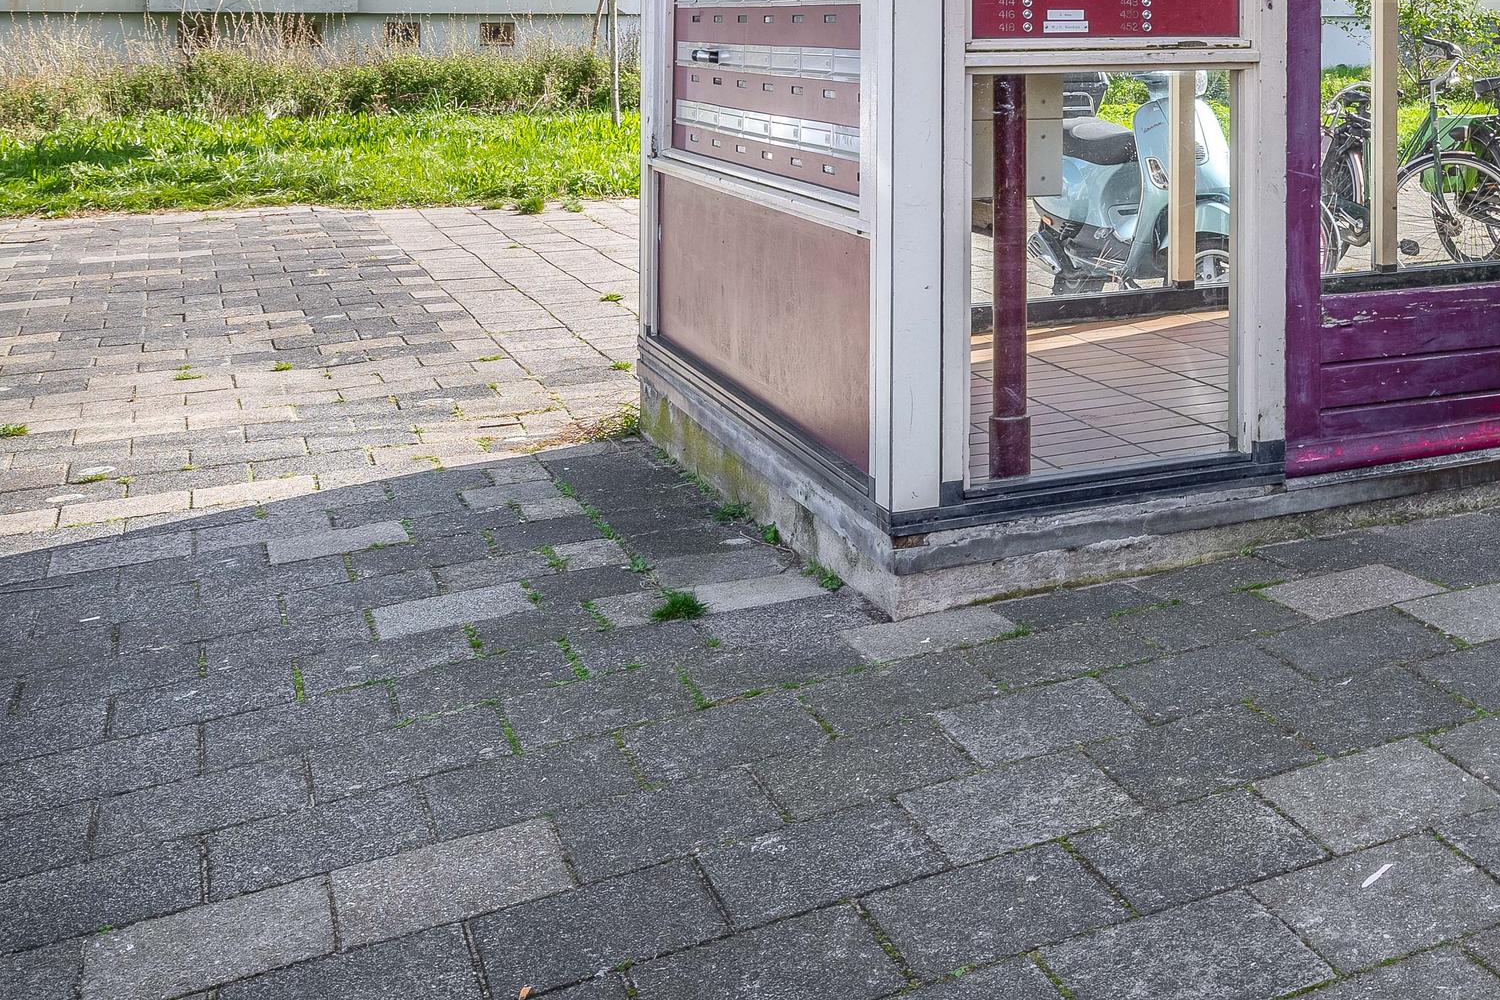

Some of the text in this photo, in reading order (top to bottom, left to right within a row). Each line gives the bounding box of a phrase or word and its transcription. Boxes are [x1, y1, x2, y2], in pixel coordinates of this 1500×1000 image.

[998, 10, 1015, 19] 416
[998, 23, 1015, 32] 418
[1120, 22, 1139, 32] 452
